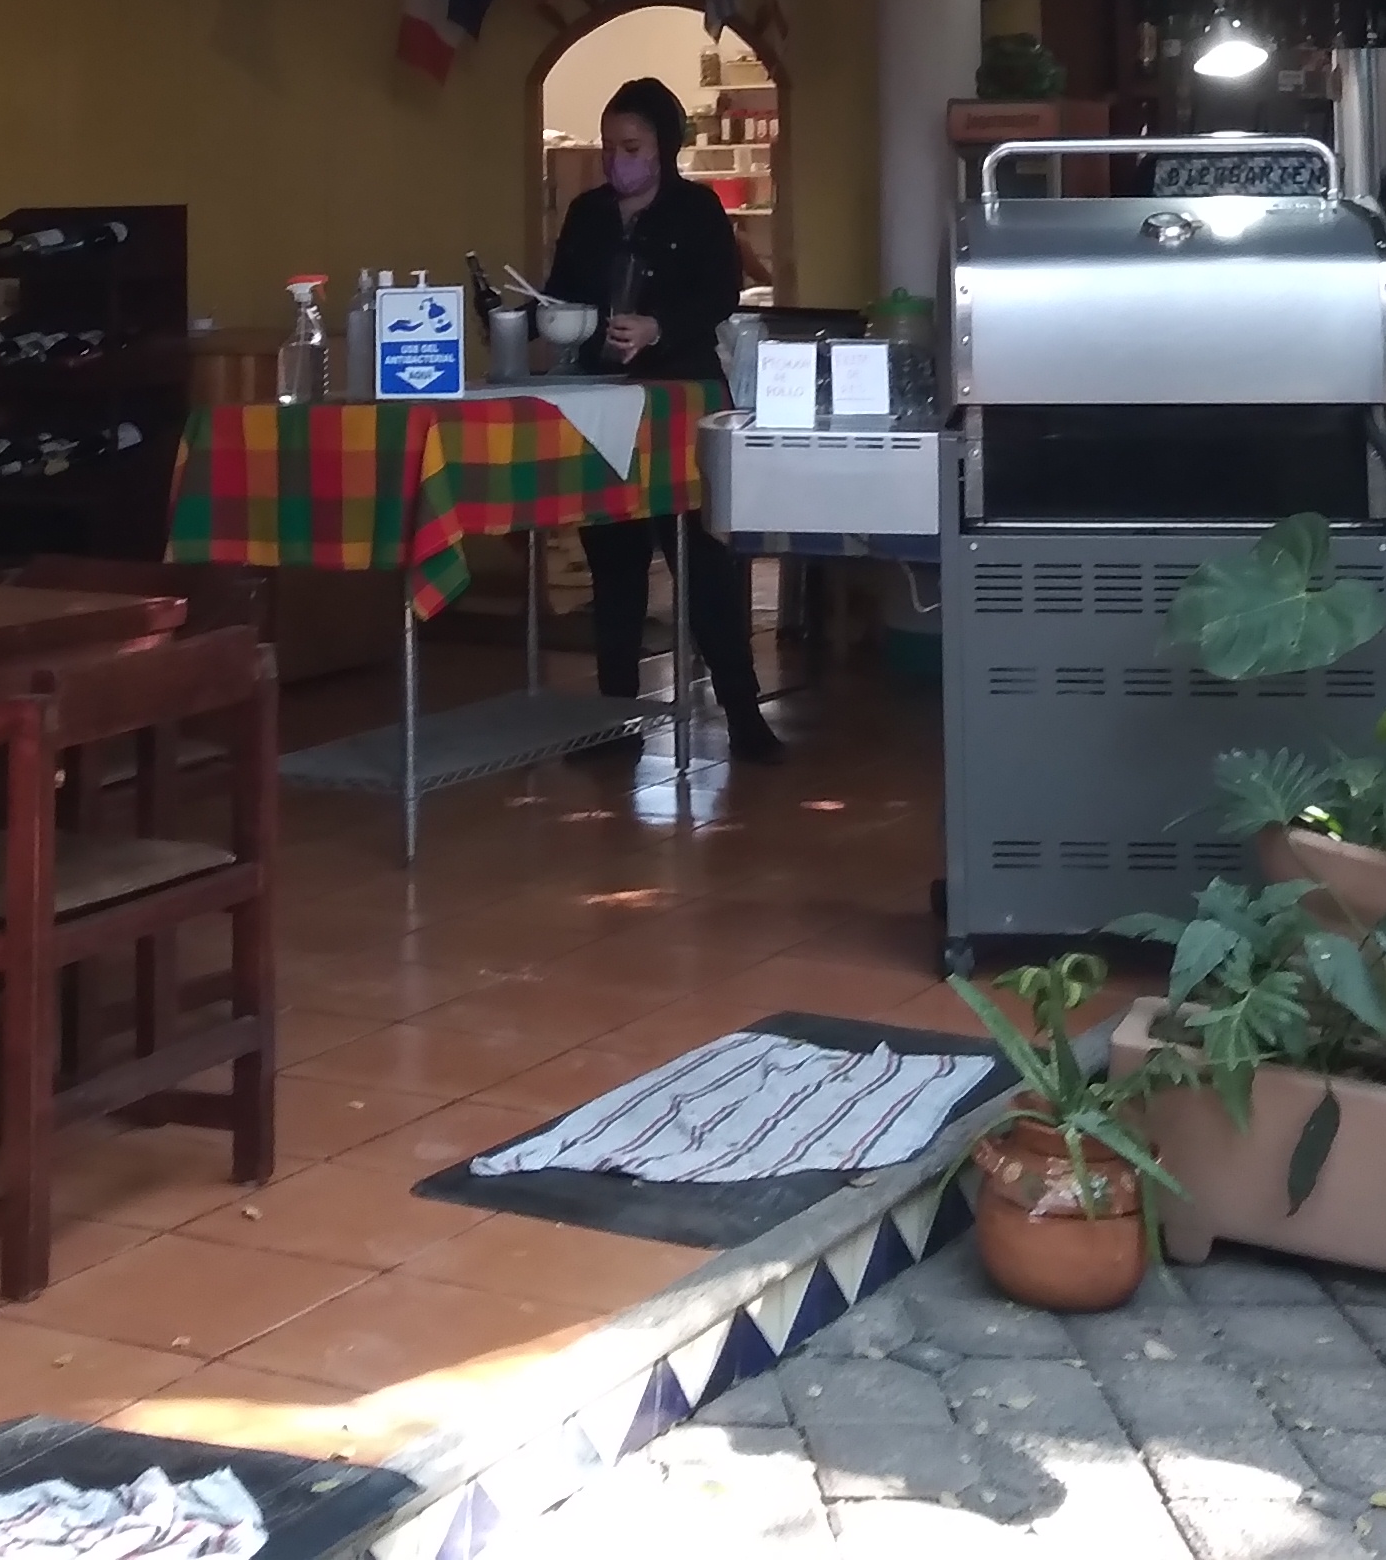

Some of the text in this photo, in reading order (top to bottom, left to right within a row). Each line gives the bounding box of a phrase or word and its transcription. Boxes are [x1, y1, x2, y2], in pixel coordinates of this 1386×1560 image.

[1165, 162, 1325, 187] BIERGARTEN
[400, 343, 439, 354] USE GEL
[384, 353, 456, 365] ANTIBACTERIAL
